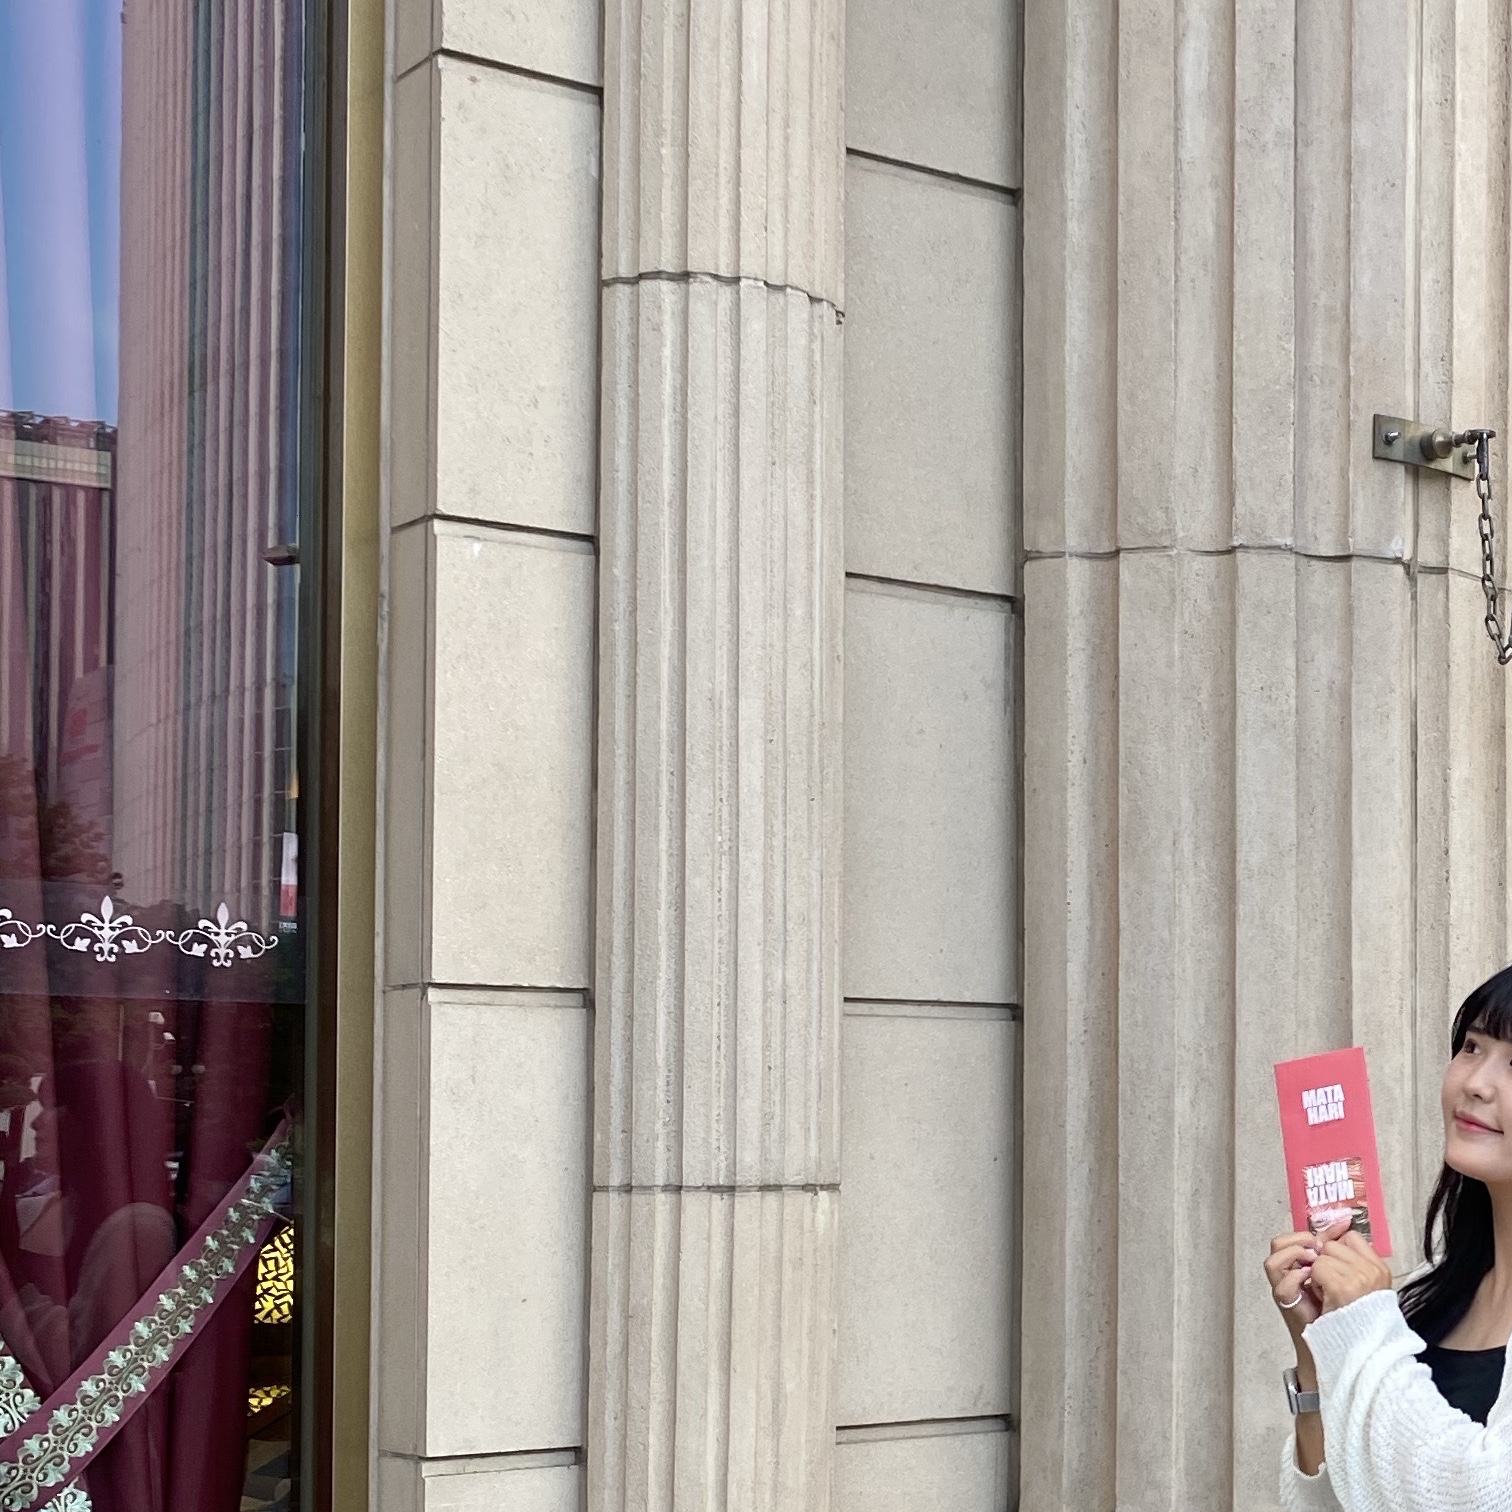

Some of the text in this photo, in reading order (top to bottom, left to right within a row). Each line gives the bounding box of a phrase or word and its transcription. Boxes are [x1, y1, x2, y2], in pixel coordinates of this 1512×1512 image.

[1302, 1083, 1345, 1110] MATA
[1306, 1101, 1345, 1125] HARI
[1306, 1161, 1349, 1188] HARI
[1306, 1179, 1355, 1208] MATA
